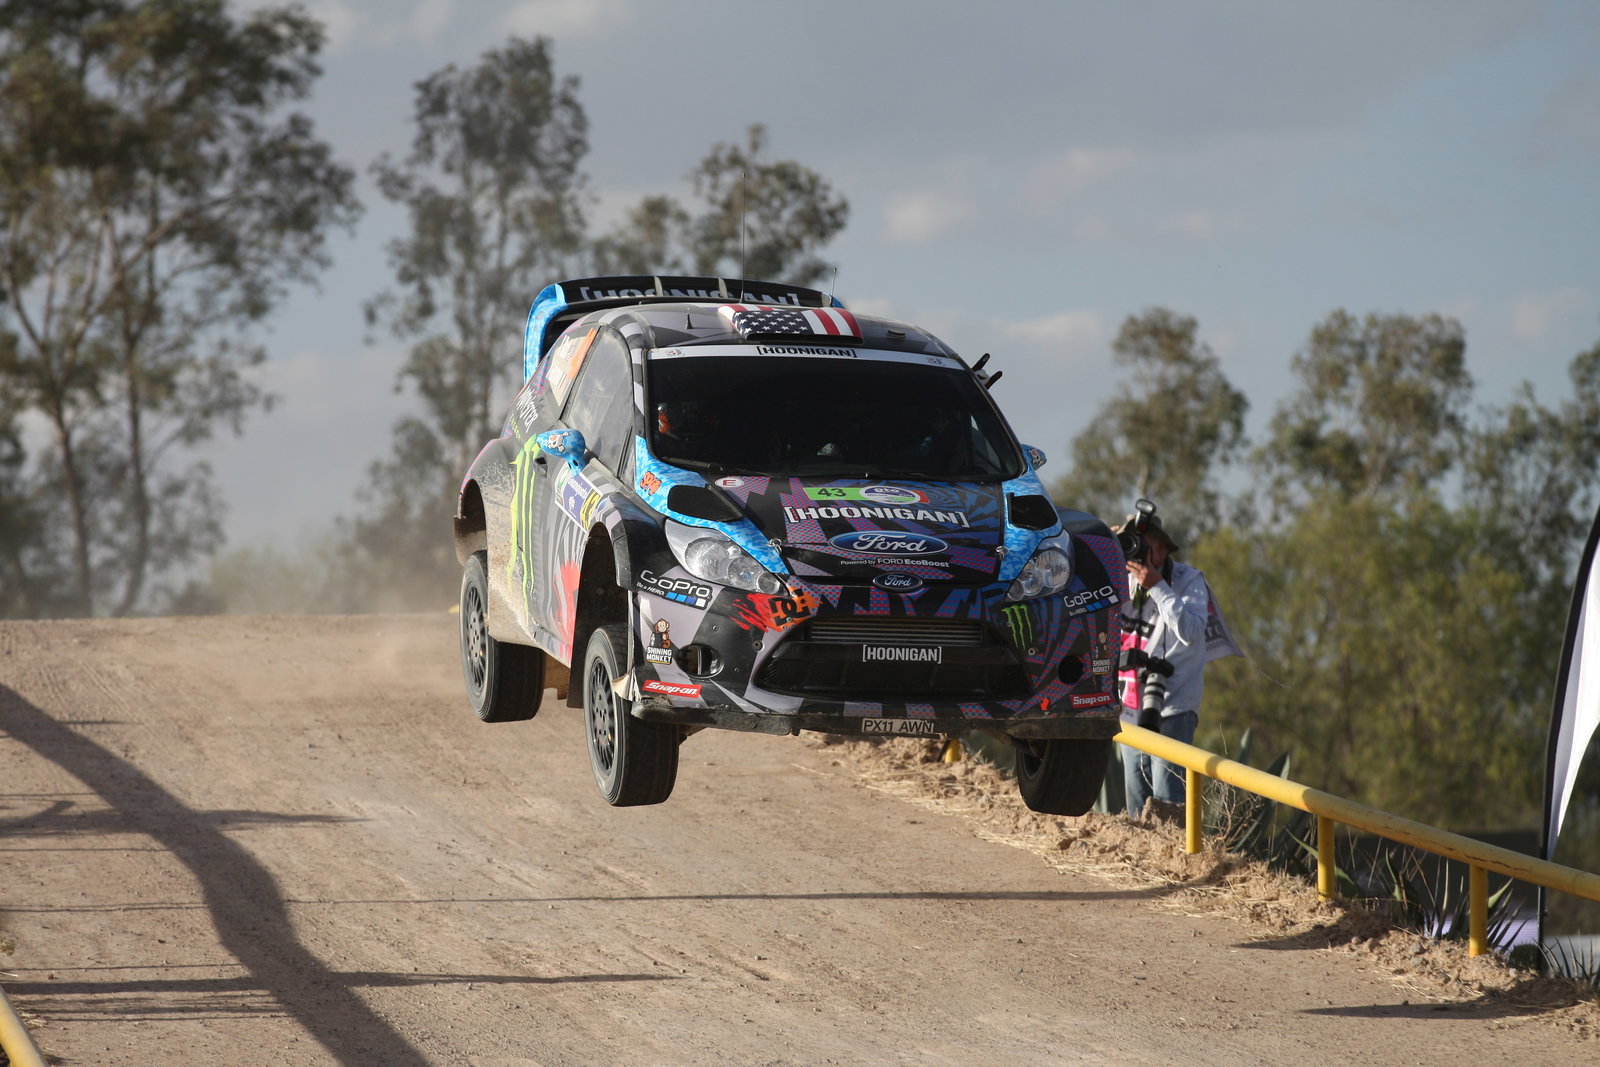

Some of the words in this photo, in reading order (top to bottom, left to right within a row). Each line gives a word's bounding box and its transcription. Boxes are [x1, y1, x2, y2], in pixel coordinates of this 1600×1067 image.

[757, 345, 857, 358] [HOONIGAN]
[817, 488, 846, 498] 43
[783, 506, 971, 528] [HOONIGAN]
[853, 535, 928, 553] Ford
[904, 558, 950, 567] EcoBoost
[640, 569, 710, 598] GoPro
[885, 575, 912, 587] Ford
[1063, 585, 1114, 608] GoPro
[647, 646, 672, 656] SHINING
[862, 645, 942, 664] [HOONIGAN]
[646, 654, 672, 663] MONKEY
[1092, 659, 1111, 667] SHINING
[1073, 695, 1110, 705] Snap-on
[863, 720, 894, 732] PX11
[898, 721, 933, 734] AWN
